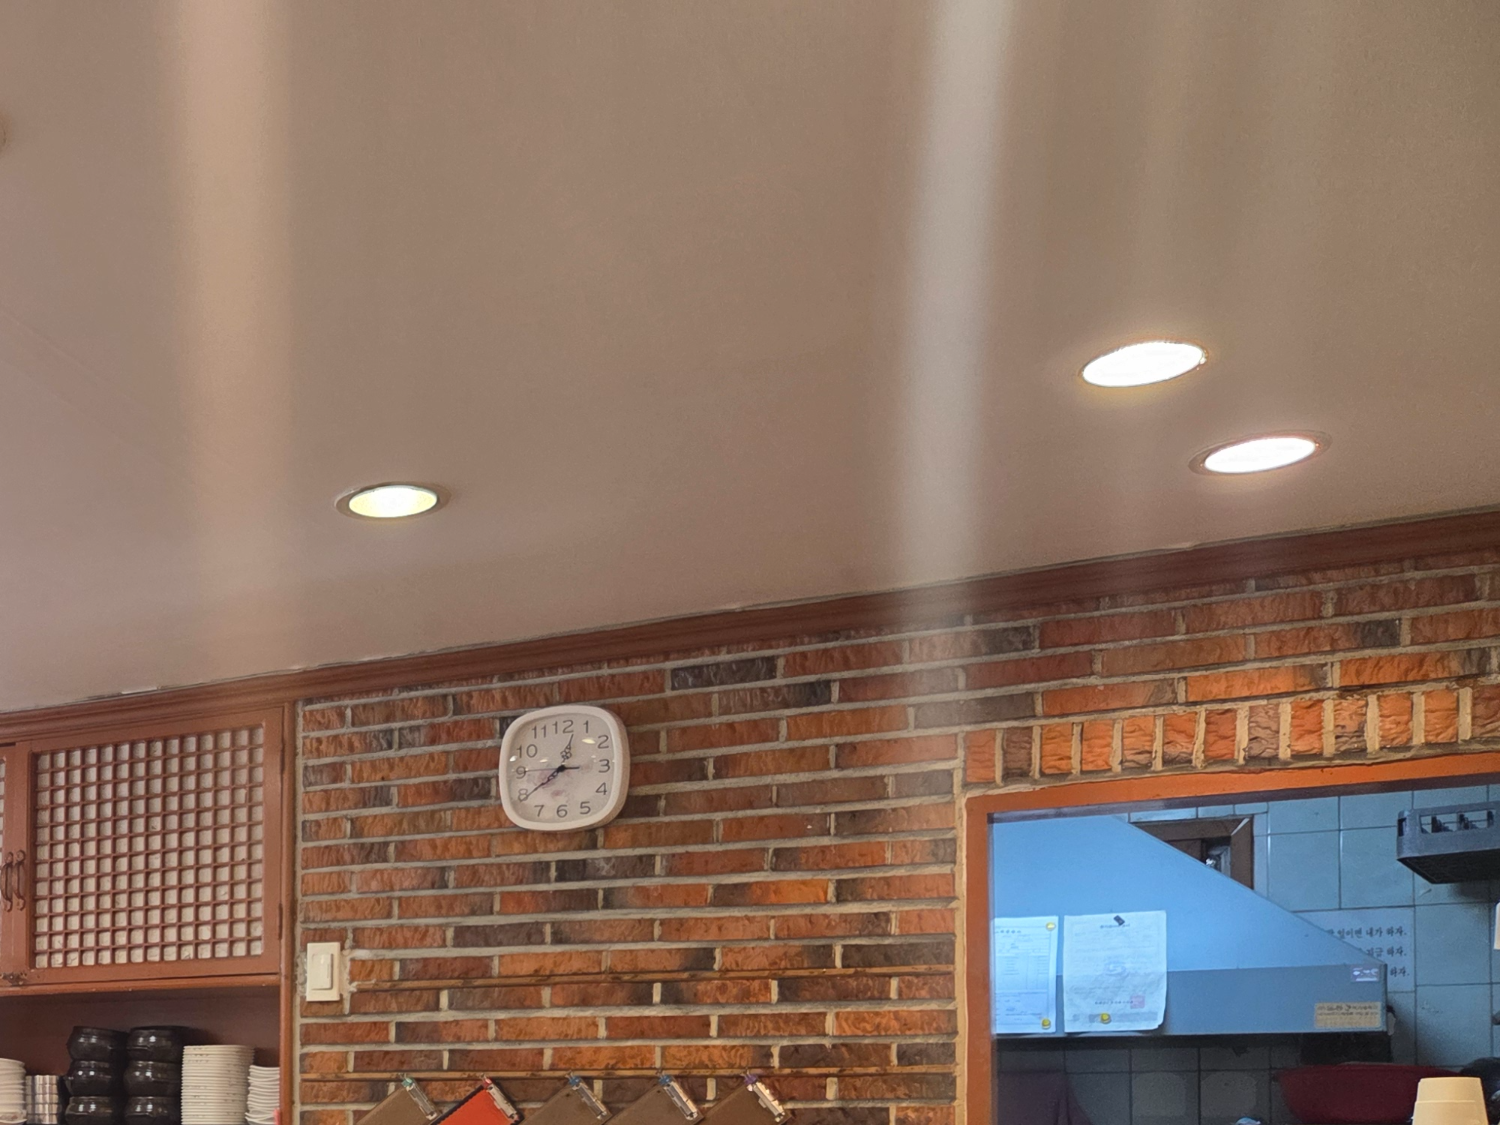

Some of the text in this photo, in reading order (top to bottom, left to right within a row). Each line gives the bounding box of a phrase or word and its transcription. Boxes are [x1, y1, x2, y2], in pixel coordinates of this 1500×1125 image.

[531, 726, 547, 739] 11
[552, 719, 574, 734] 12
[583, 719, 590, 733] 1
[597, 734, 609, 749] 2
[516, 743, 538, 758] 10
[515, 766, 527, 779] 9
[598, 758, 611, 773] 3
[517, 788, 529, 802] 8
[595, 782, 608, 796] 4
[533, 804, 545, 817] 7
[556, 804, 568, 818] 6
[579, 801, 591, 815] 5
